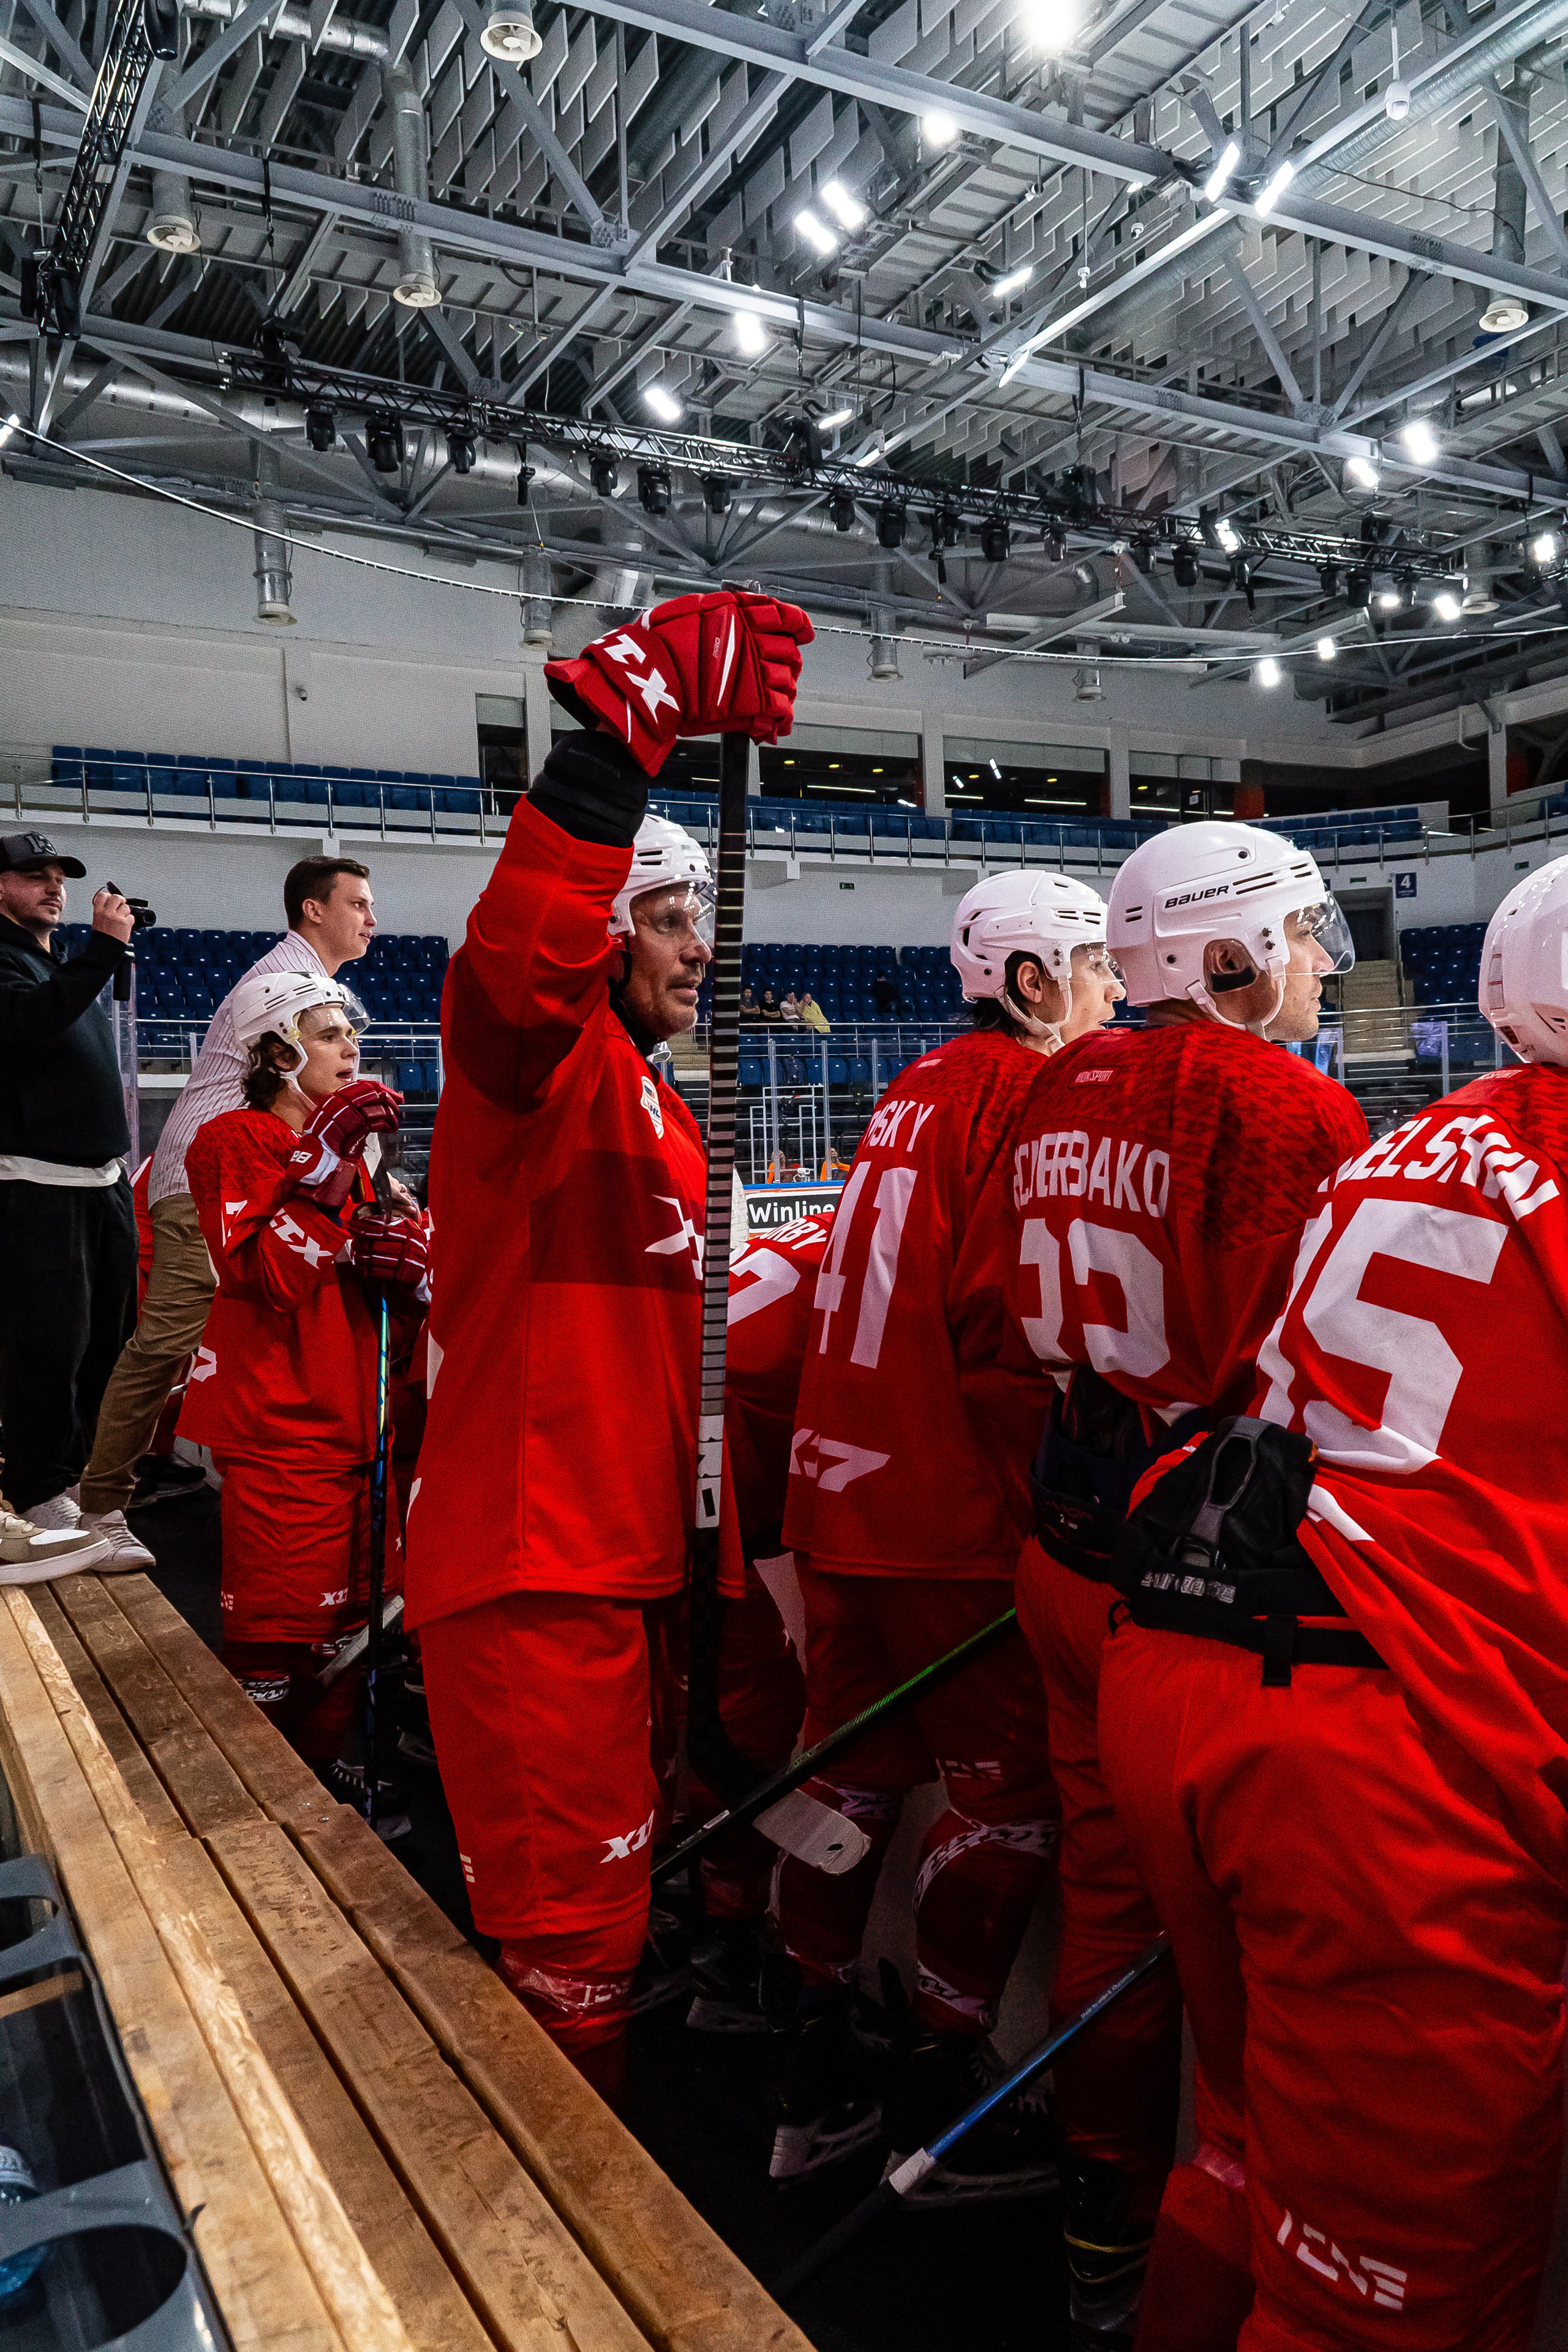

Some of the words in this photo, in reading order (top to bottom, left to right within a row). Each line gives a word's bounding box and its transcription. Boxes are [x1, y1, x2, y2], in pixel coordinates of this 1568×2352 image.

[1400, 875, 1411, 888] 4
[1164, 885, 1229, 909] BAUER
[748, 1200, 835, 1223] Winline
